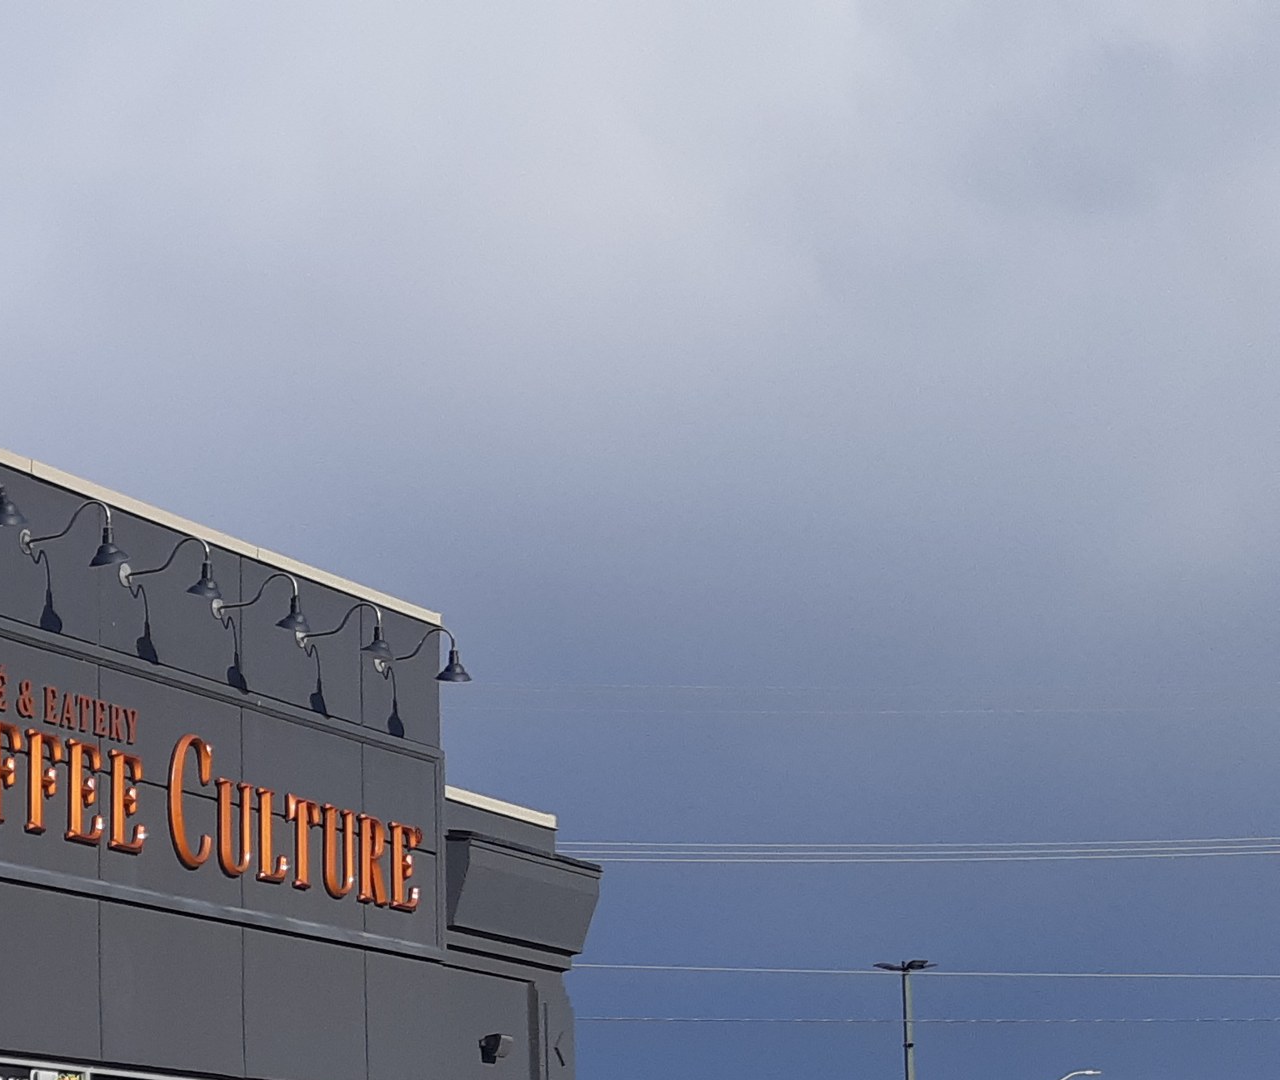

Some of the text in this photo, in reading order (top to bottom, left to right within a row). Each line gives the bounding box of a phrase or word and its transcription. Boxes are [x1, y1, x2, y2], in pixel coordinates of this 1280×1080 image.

[18, 677, 36, 718] &
[43, 684, 138, 745] EATERY
[167, 733, 423, 912] CULTURE
